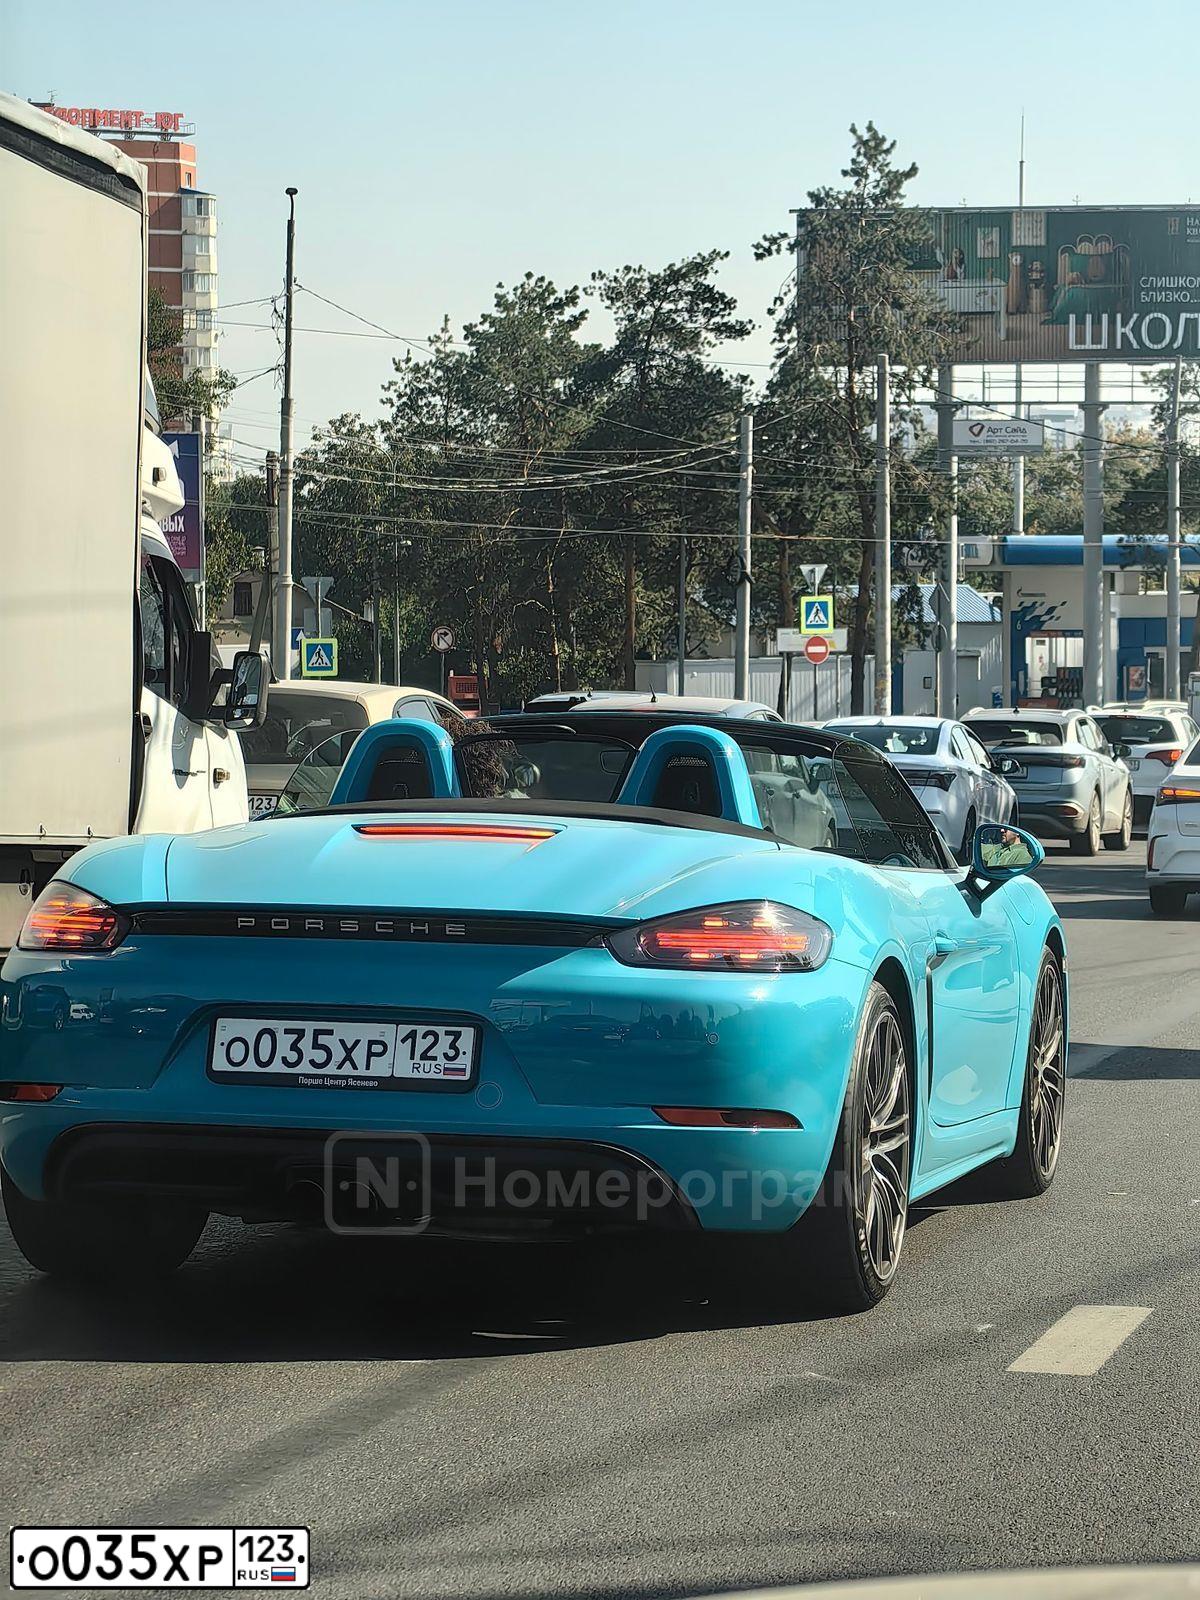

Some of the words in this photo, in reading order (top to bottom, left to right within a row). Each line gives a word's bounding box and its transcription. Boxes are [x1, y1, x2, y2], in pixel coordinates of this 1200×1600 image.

[1068, 311, 1200, 350] ШКОЛ
[986, 426, 1003, 434] Арт
[159, 515, 185, 532] ВЫХ
[1016, 620, 1022, 630] 6
[248, 798, 272, 810] 123
[237, 917, 467, 936] PORSCHE
[400, 1029, 463, 1061] 123
[411, 1062, 442, 1075] RUS
[298, 1076, 323, 1086] Порше
[324, 1077, 347, 1087] Центр
[347, 1078, 379, 1088] Ясенево
